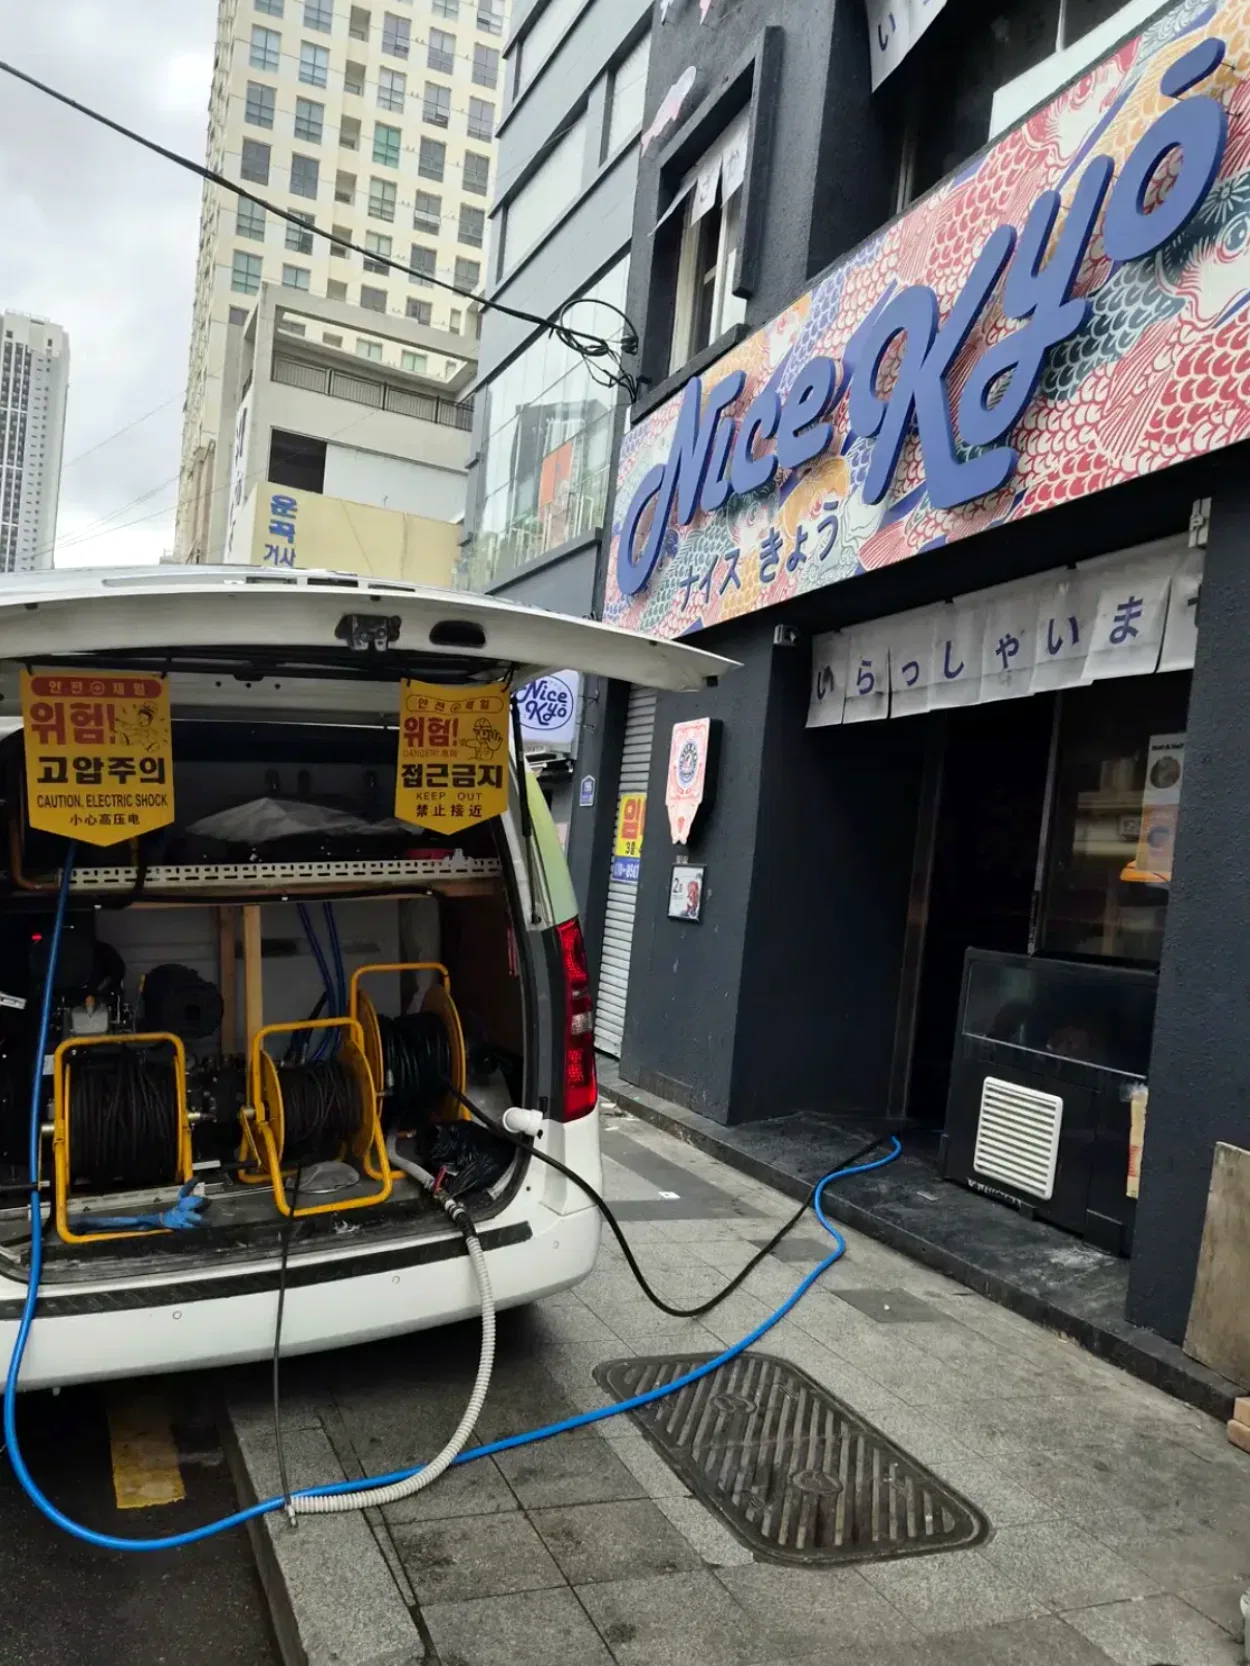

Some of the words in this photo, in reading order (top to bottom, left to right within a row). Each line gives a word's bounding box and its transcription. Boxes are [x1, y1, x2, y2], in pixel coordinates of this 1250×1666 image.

[616, 354, 845, 596] Nice
[680, 550, 741, 610] ナイス
[759, 502, 839, 583] きょう
[817, 595, 1200, 701] いらっしゃいま
[518, 679, 568, 703] Nice
[29, 702, 116, 745] 위험!
[403, 716, 459, 748] 위험!
[37, 756, 166, 785] 고압주의
[401, 763, 503, 789] 접근금지
[86, 793, 132, 808] ELECTRIC
[136, 793, 168, 807] SHOCK
[416, 791, 446, 800] KEEP
[457, 791, 483, 800] OUT
[70, 813, 140, 826] 小心高压电
[416, 803, 483, 818] 禁止接近
